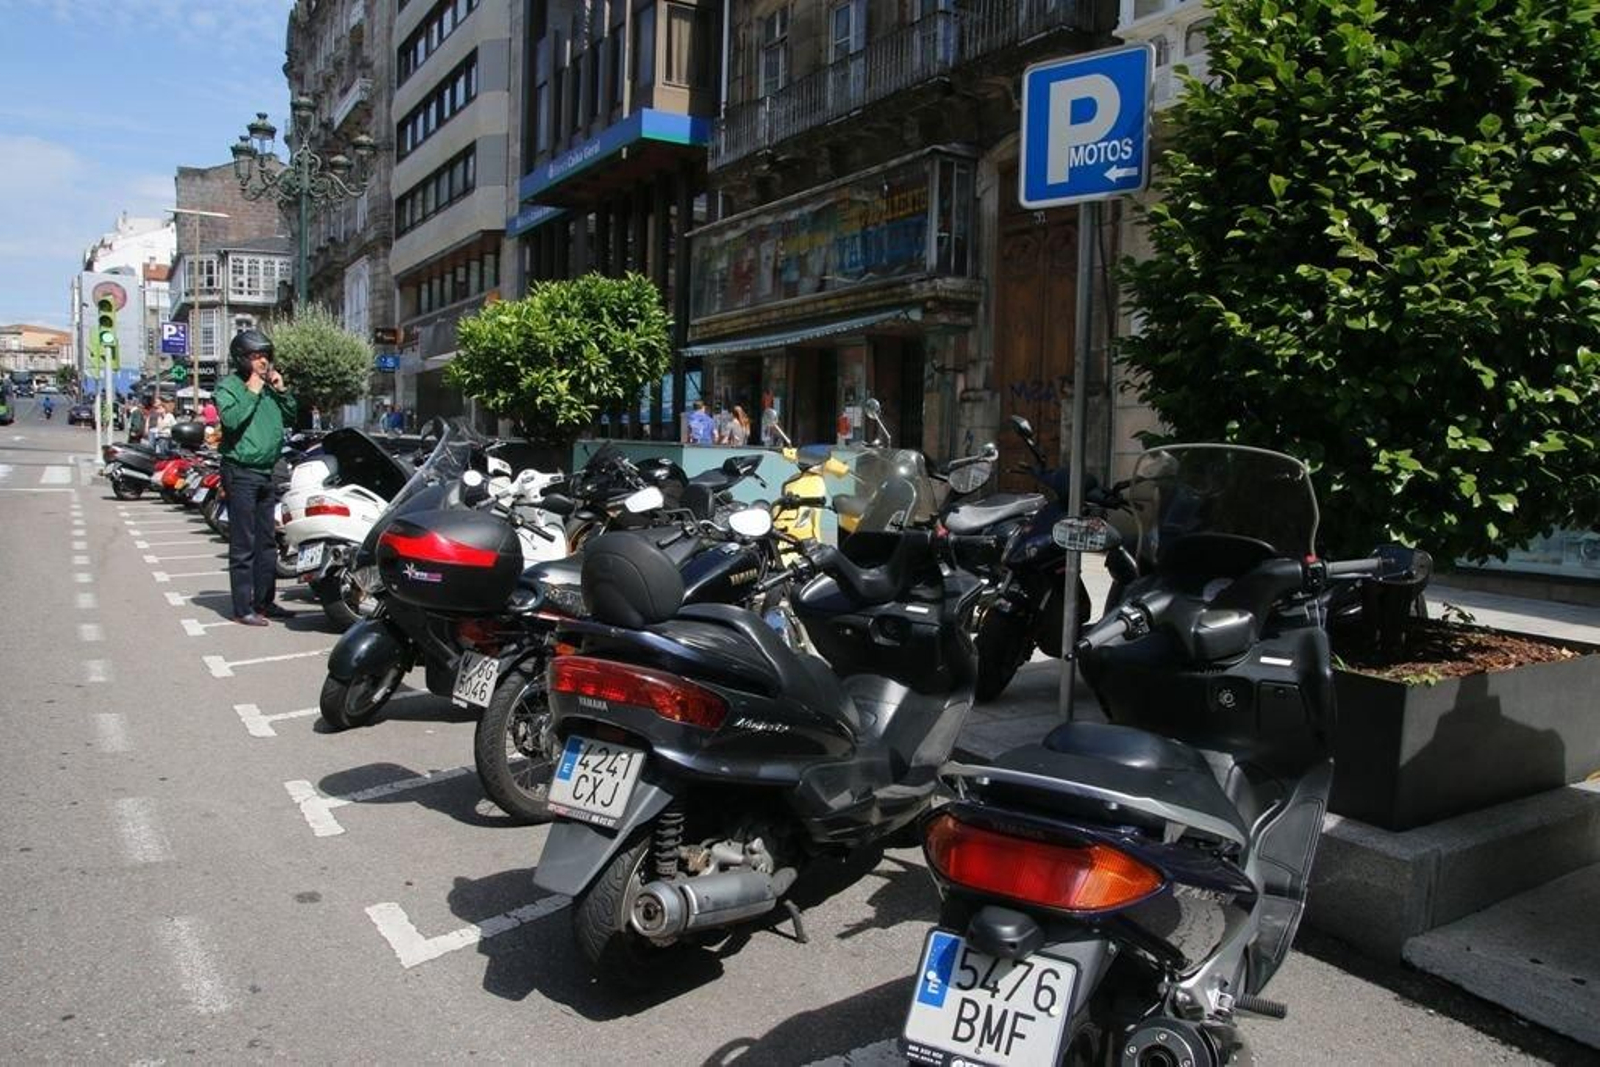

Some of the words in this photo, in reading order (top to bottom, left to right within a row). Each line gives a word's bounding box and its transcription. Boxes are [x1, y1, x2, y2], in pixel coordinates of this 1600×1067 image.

[1047, 73, 1121, 185] P
[1069, 138, 1133, 168] MOTOS
[163, 324, 177, 340] P
[578, 697, 608, 712] YAMAHA
[578, 744, 634, 779] 4241
[573, 774, 619, 807] CXJ
[927, 978, 941, 994] E
[956, 947, 1061, 1017] 5476
[952, 997, 1036, 1056] BMF
